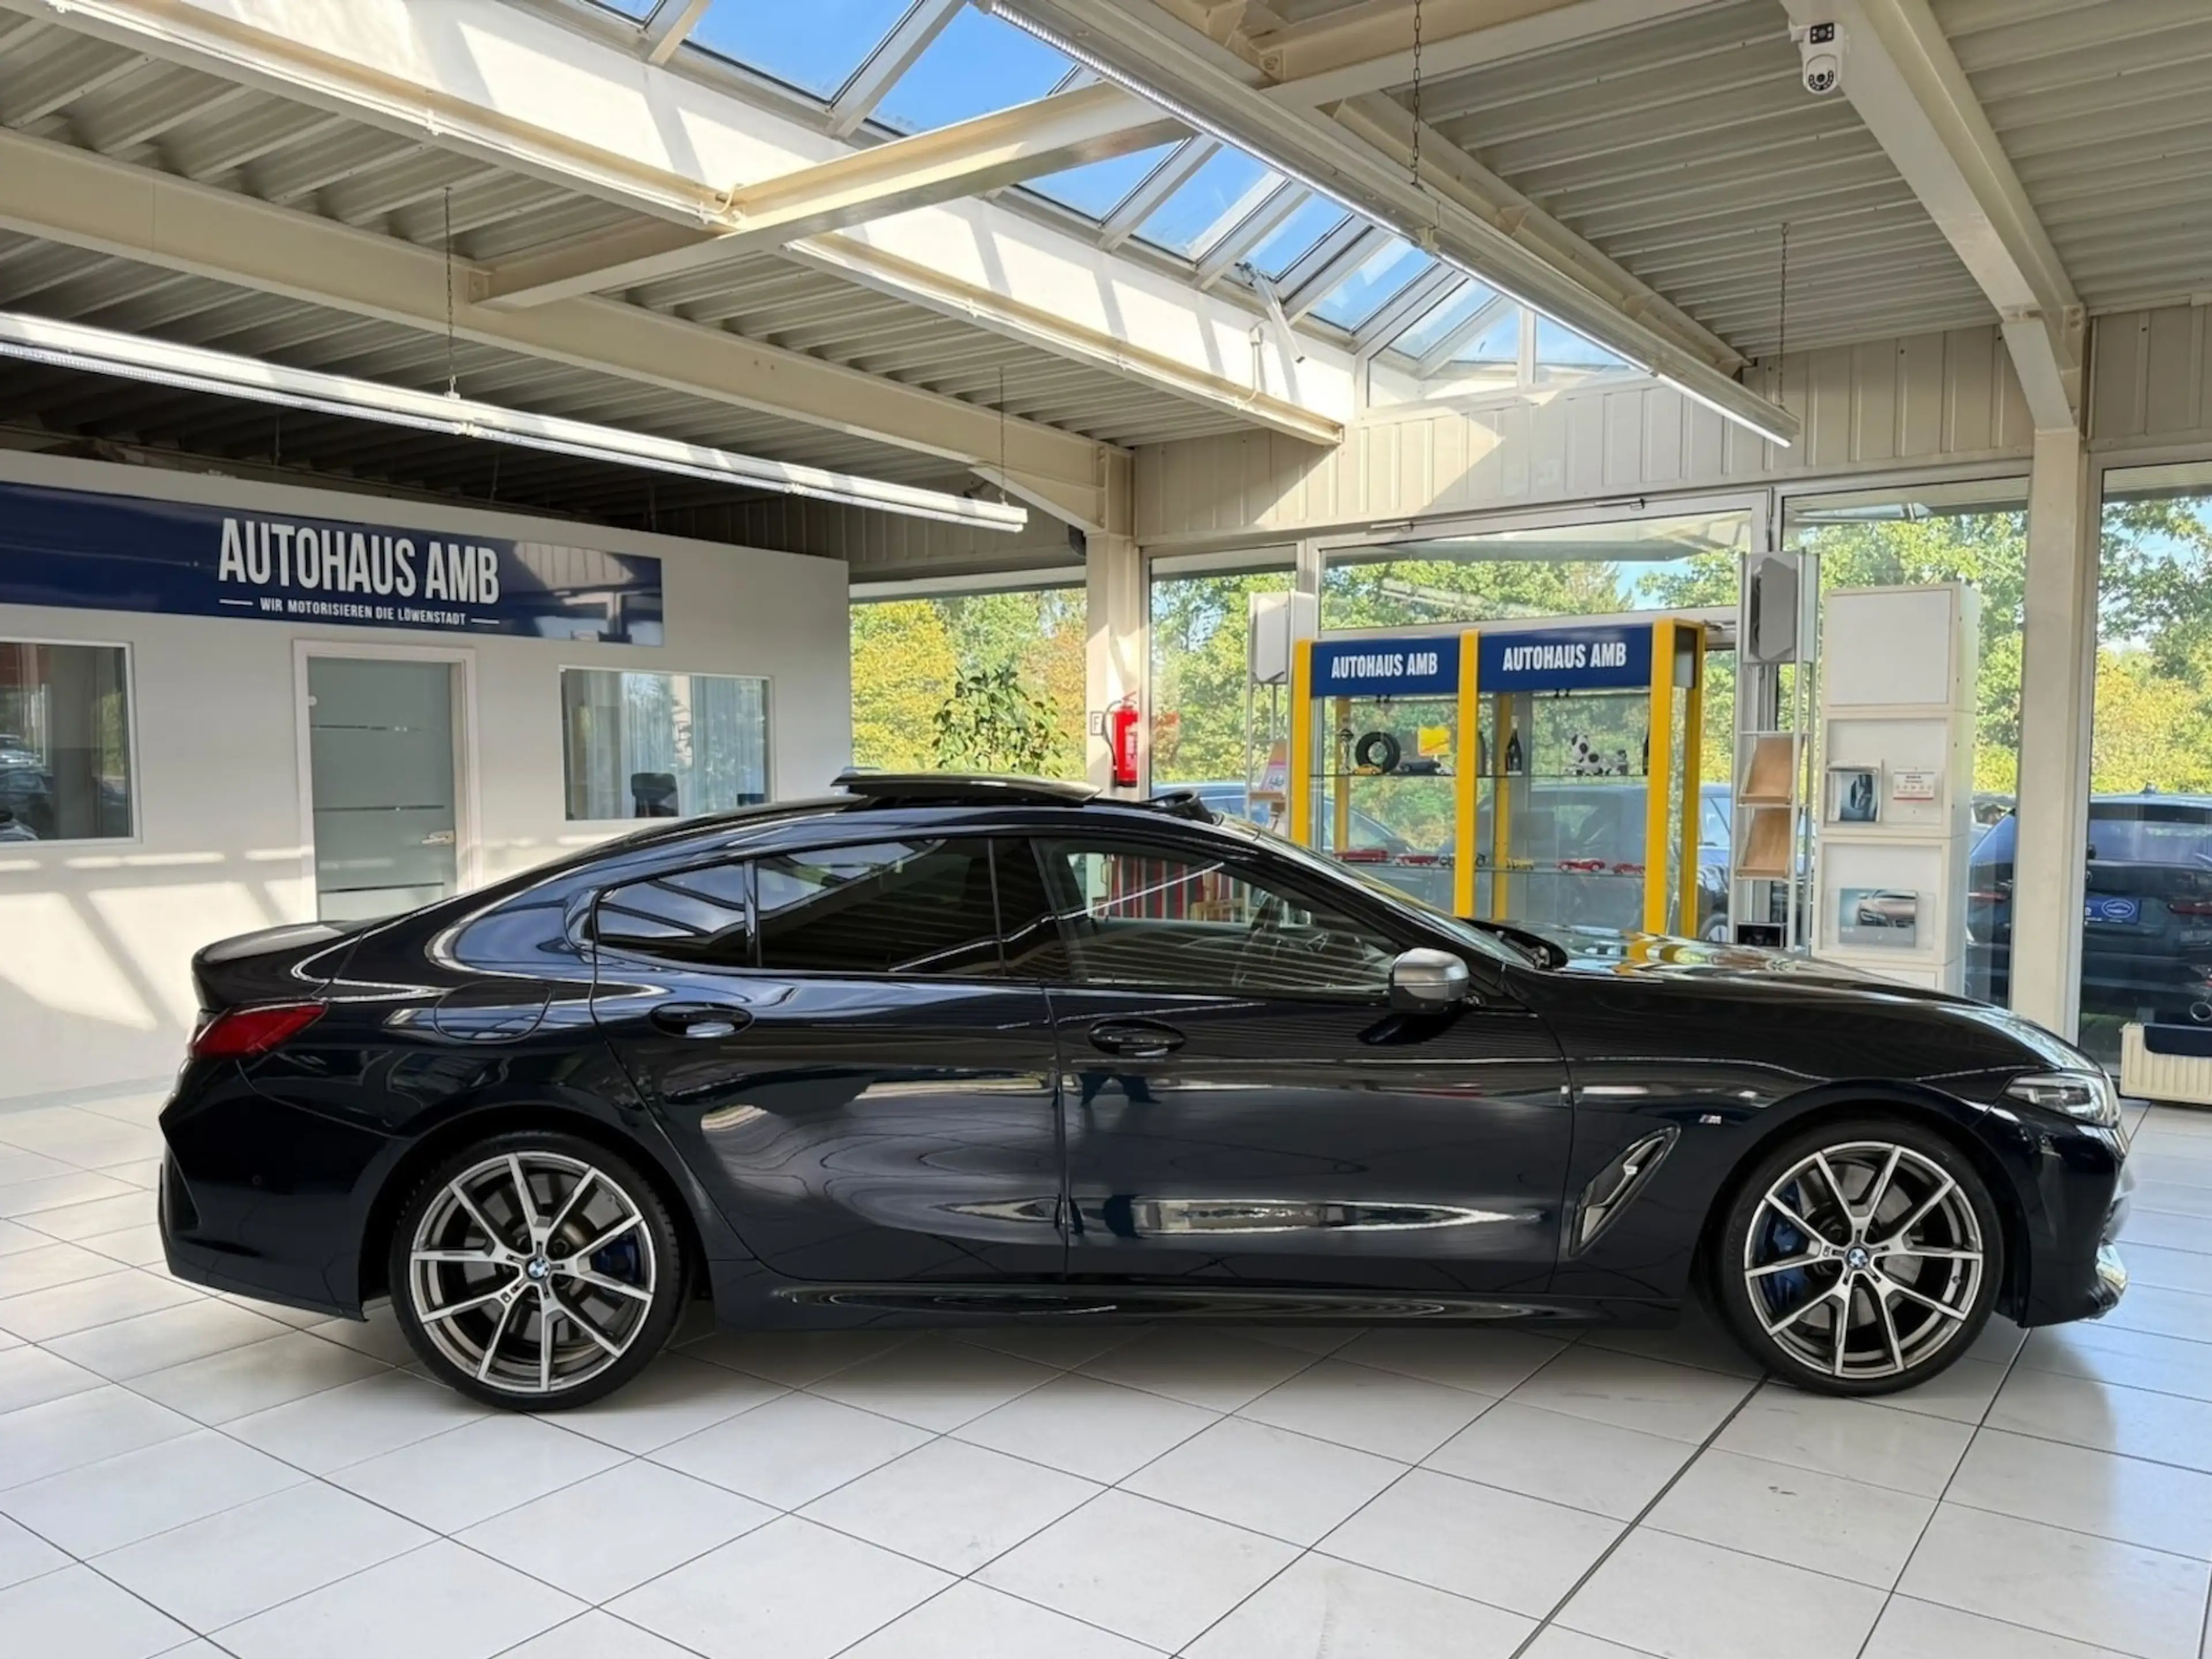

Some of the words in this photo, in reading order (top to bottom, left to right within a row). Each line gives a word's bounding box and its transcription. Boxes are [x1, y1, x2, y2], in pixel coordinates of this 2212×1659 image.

[218, 518, 416, 597] AUTOHAUS
[425, 541, 500, 605] AMB
[260, 597, 283, 612] WIR
[288, 600, 373, 619] MOTORISIEREN
[376, 607, 394, 620] DIE
[398, 606, 467, 626] LÖWENSTADT
[1331, 654, 1403, 679] AUTOHAUS
[1407, 653, 1438, 676] AMB
[1503, 645, 1586, 671] AUTOHAUS
[1590, 643, 1626, 668] AMB
